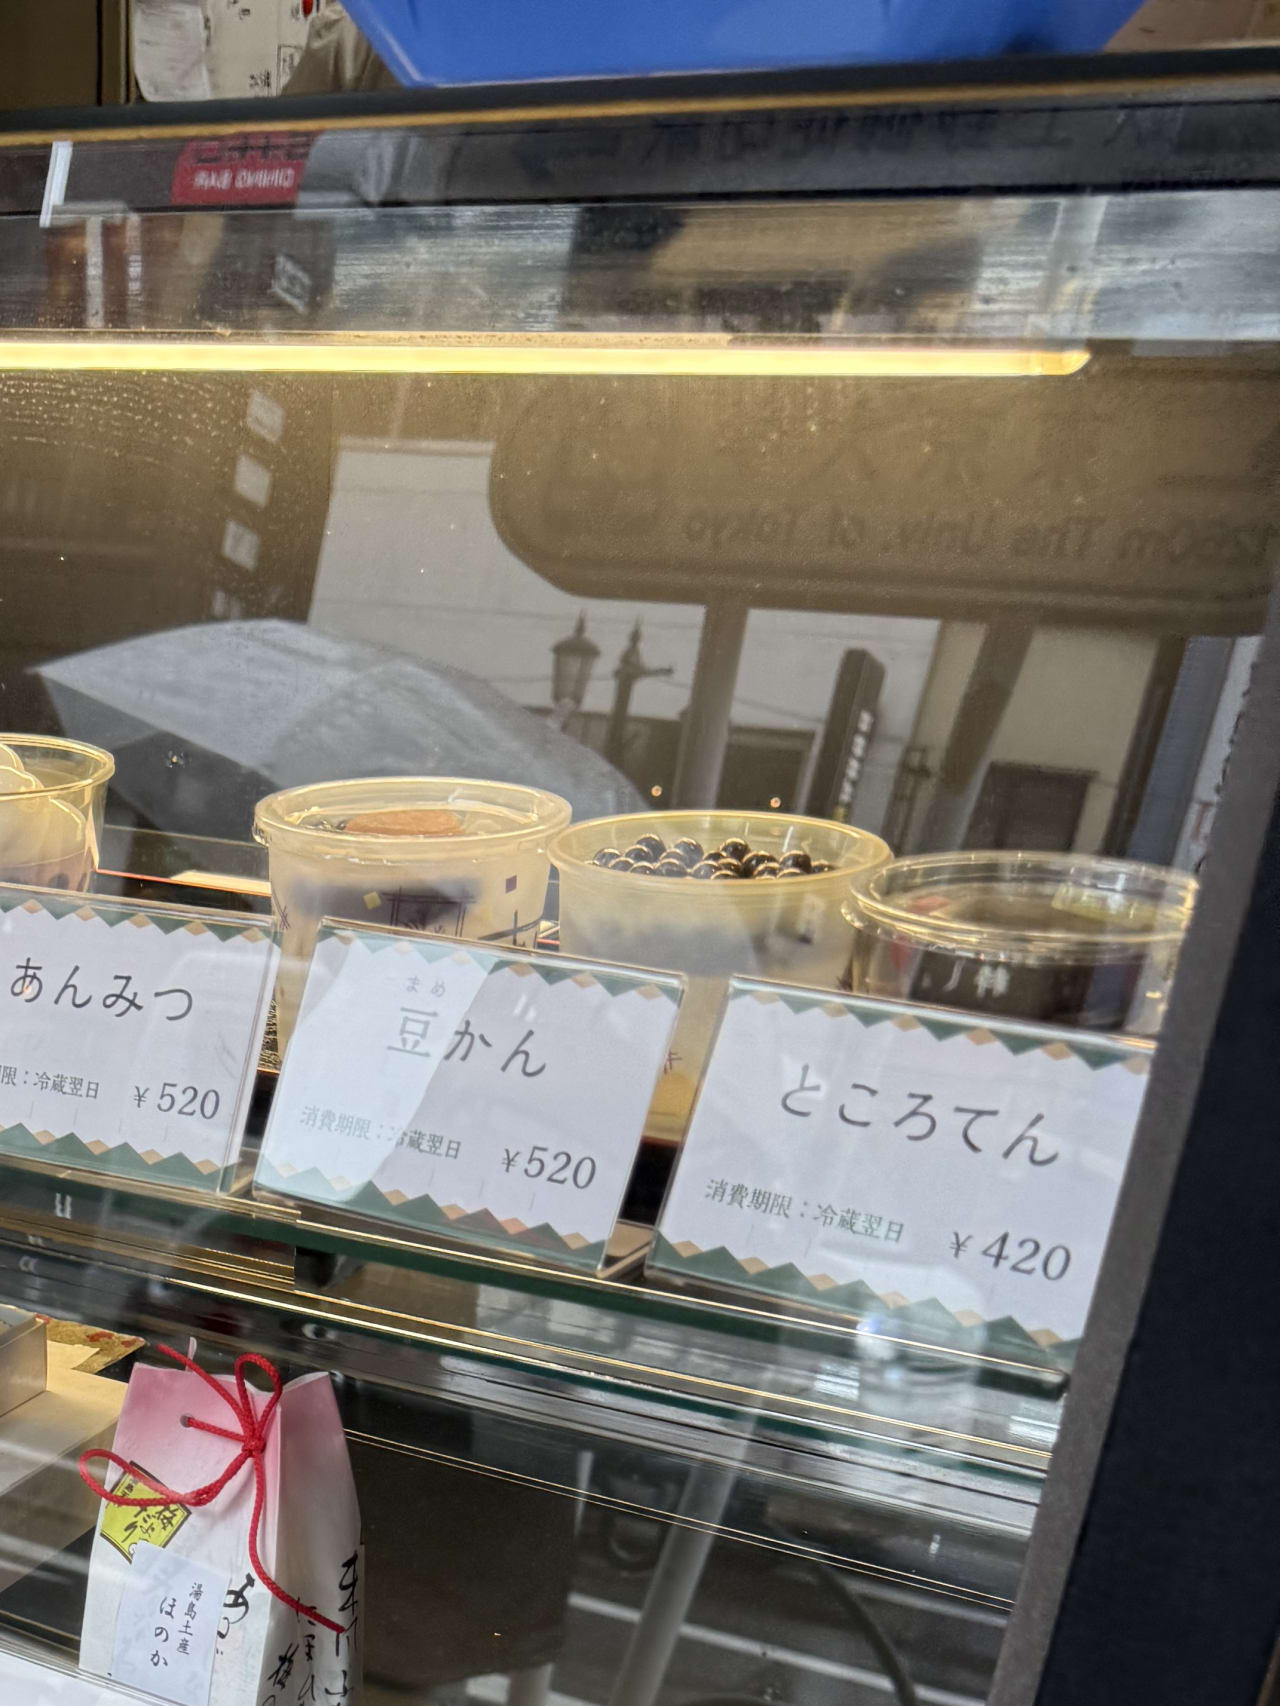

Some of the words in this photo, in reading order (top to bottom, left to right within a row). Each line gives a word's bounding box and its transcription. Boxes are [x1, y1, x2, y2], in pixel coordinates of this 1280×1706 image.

[10, 957, 193, 1021] あんみつ
[407, 975, 446, 997] まめ
[386, 1006, 547, 1078] 豆かん
[133, 1082, 220, 1120] ¥520
[780, 1063, 1059, 1167] ところてん
[502, 1146, 596, 1190] ¥520
[704, 1178, 905, 1243] 消費期限：冷蔵翌日
[950, 1231, 1072, 1282] ¥420
[150, 1596, 177, 1667] ほのか
[176, 1582, 203, 1655] 湯島土産
